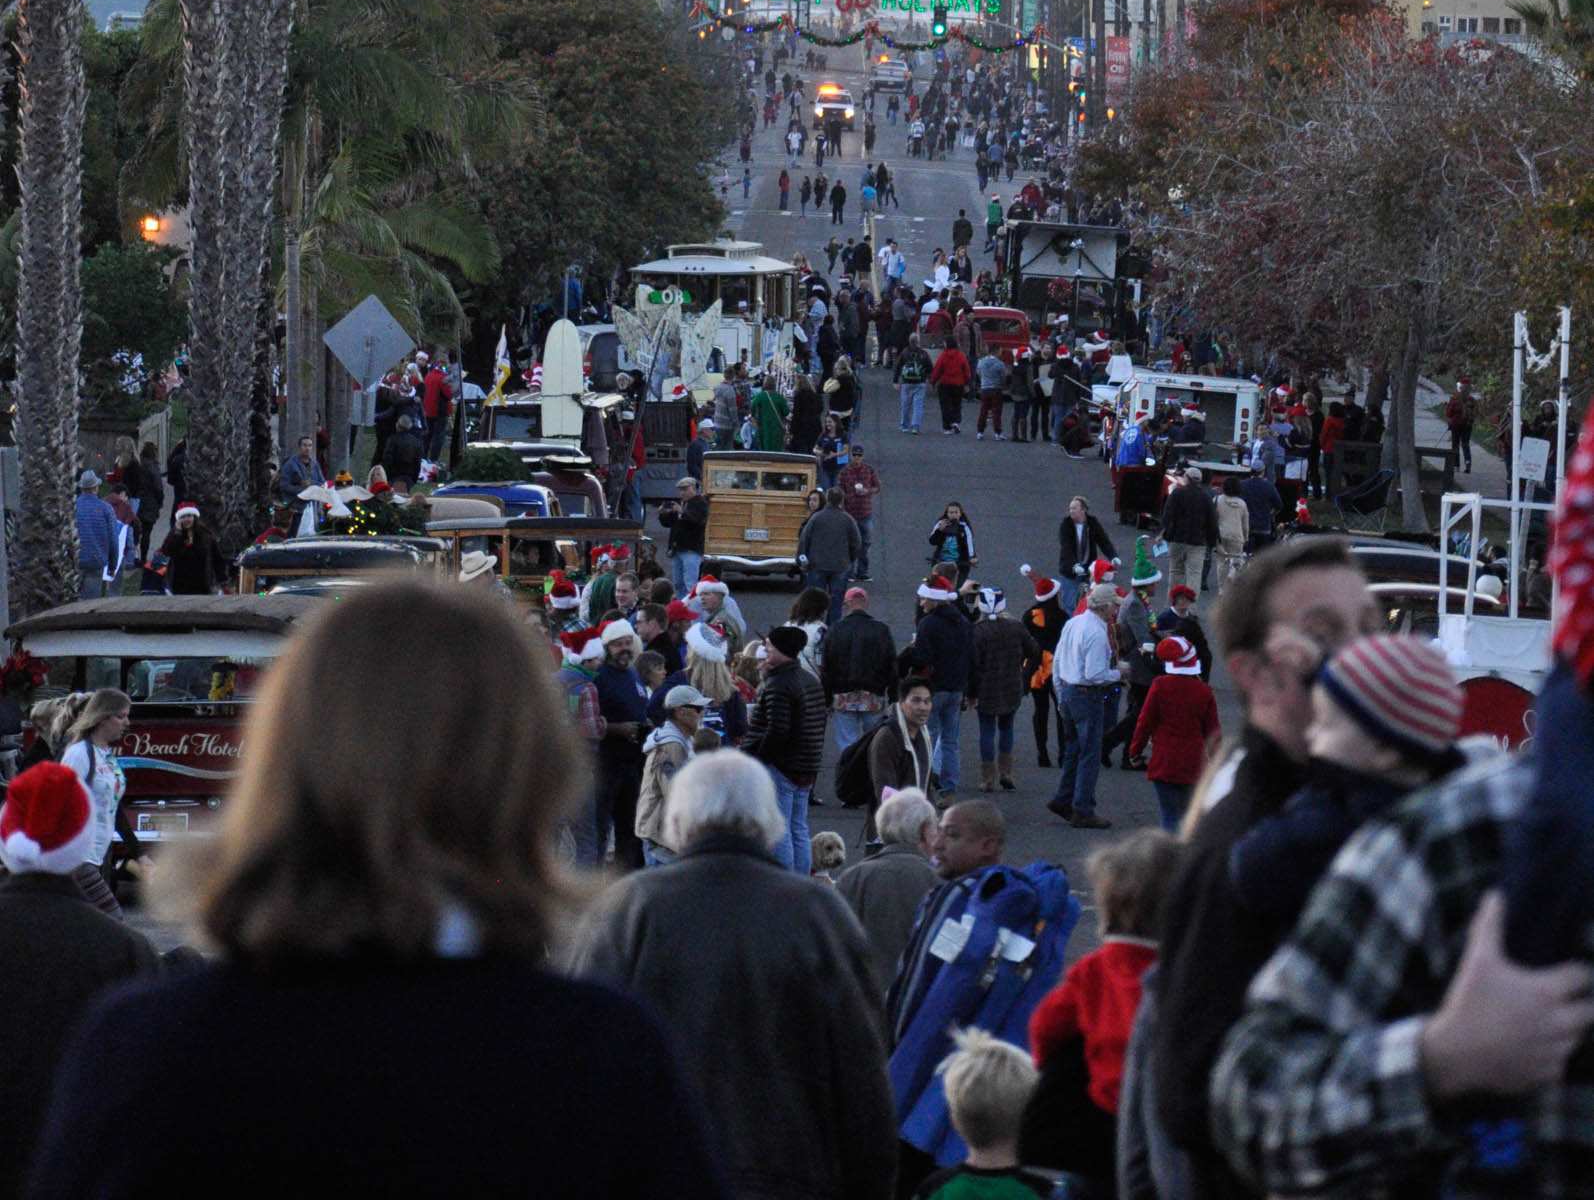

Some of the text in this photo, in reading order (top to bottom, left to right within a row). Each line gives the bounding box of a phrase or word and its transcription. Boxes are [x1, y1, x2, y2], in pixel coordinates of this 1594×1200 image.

[662, 289, 684, 305] OB
[123, 733, 189, 756] Beach
[191, 732, 244, 758] Hotel
